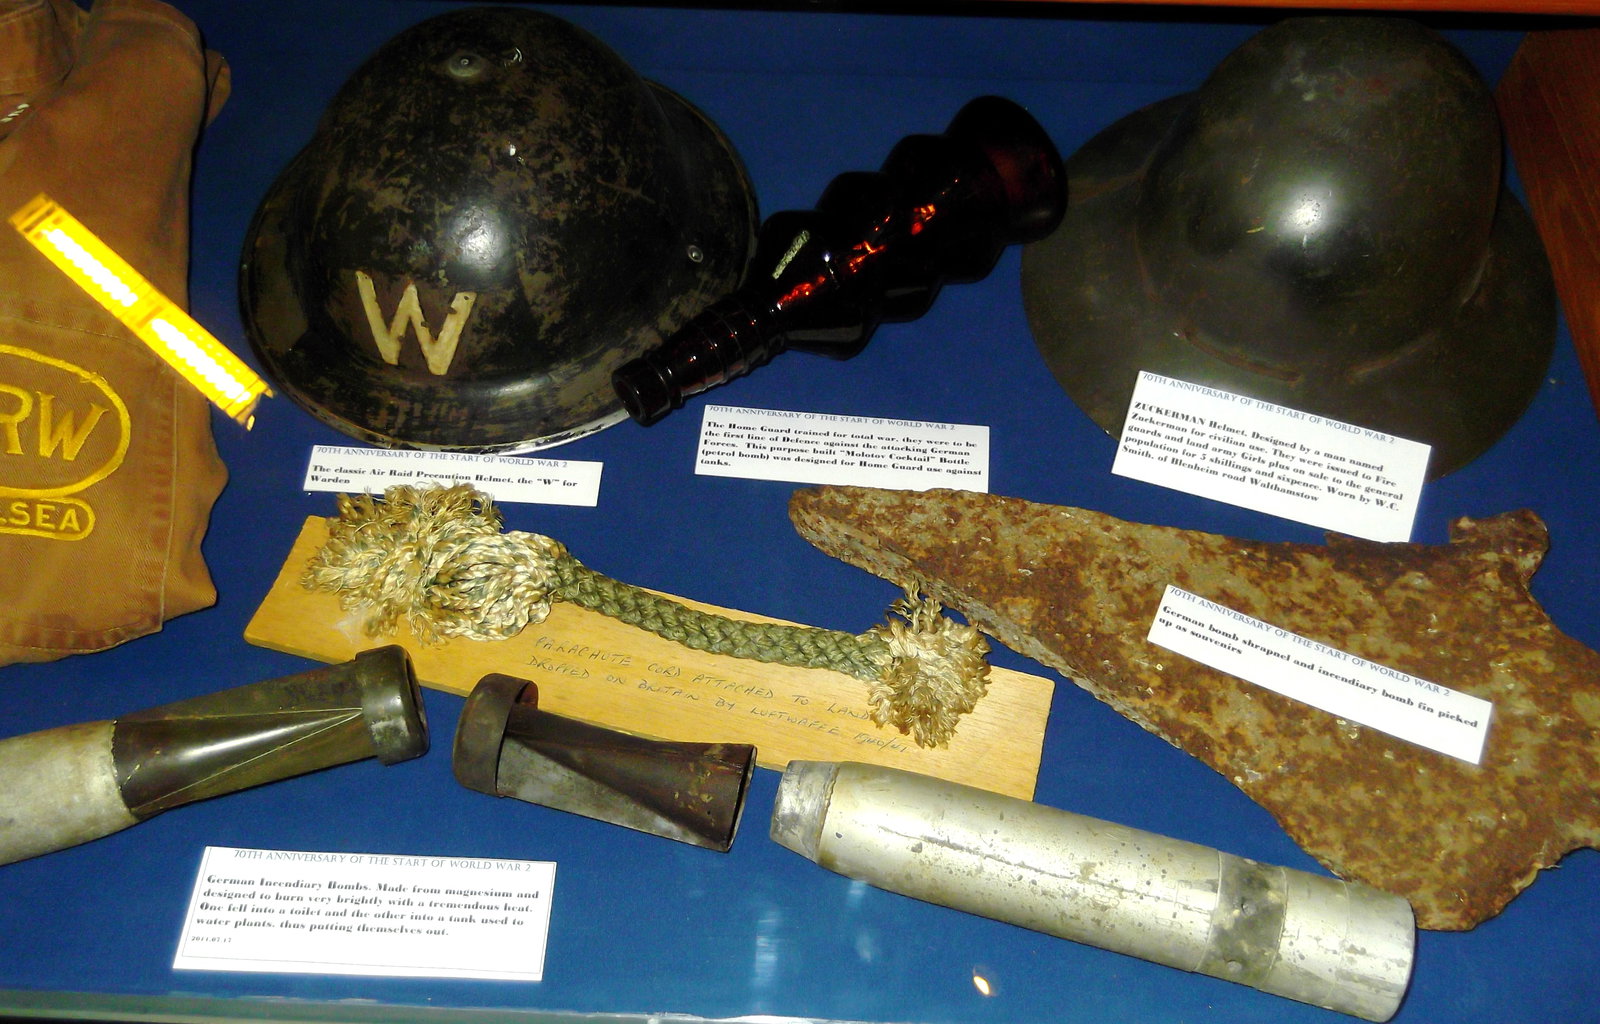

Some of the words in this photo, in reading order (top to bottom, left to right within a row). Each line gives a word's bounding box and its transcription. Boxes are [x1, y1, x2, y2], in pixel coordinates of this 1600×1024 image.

[355, 270, 477, 375] W
[1143, 372, 1167, 385] 70TH
[1168, 379, 1238, 402] ANNIVERSARY
[1239, 397, 1254, 406] OF
[1255, 400, 1275, 412] THE
[1275, 406, 1307, 420] START
[1308, 415, 1322, 424] OF
[1324, 419, 1361, 435] WORLD
[1363, 429, 1386, 442] WAR
[1388, 436, 1395, 445] 2
[703, 438, 738, 448] Forces.
[744, 442, 767, 450] This
[812, 447, 836, 455] built
[939, 456, 970, 465] Bottle
[723, 431, 744, 439] first
[781, 436, 820, 445] Defence
[823, 440, 859, 448] against
[880, 445, 927, 454] attacking
[930, 447, 970, 456] German
[728, 422, 757, 431] Home
[759, 425, 791, 434] Guard
[793, 429, 830, 437] trained
[902, 436, 922, 445] they
[1131, 411, 1187, 433] Zuckerman
[1190, 427, 1206, 437] for
[1208, 432, 1245, 448] civilian
[1272, 447, 1296, 462] They
[1299, 457, 1323, 467] were
[1326, 462, 1359, 477] issued
[1361, 472, 1372, 480] to
[1375, 475, 1397, 487] Fire
[1134, 401, 1206, 425] ZUCKERMAN
[1251, 431, 1297, 449] Designed
[1299, 443, 1310, 454] by
[1323, 452, 1346, 462] man
[1348, 458, 1384, 472] named
[310, 474, 350, 484] Warden
[312, 464, 331, 472] The
[334, 466, 366, 474] classic
[369, 468, 386, 476] Air
[388, 469, 413, 477] Raid
[415, 470, 471, 481] Precaution
[562, 479, 578, 487] for
[700, 458, 731, 466] tanks.
[701, 448, 735, 457] (petrol
[738, 450, 770, 460] bomb)
[794, 455, 837, 465] designed
[859, 460, 888, 468] Home
[891, 462, 923, 471] Guard
[945, 467, 981, 476] against
[1124, 436, 1179, 454] population
[1181, 448, 1197, 458] for
[1199, 453, 1207, 461] 5
[1209, 456, 1252, 473] shillings
[1254, 469, 1275, 478] and
[1326, 485, 1356, 500] Worn
[1359, 494, 1371, 505] by
[1127, 425, 1162, 438] guards
[1164, 434, 1184, 443] and
[1186, 437, 1209, 450] land
[1211, 446, 1237, 459] army
[1240, 451, 1266, 464] Girls
[1267, 460, 1290, 471] plus
[1292, 467, 1305, 475] on
[1308, 471, 1329, 480] sale
[1332, 476, 1342, 485] to
[1345, 479, 1362, 489] the
[1363, 486, 1403, 501] general
[1170, 456, 1219, 476] Blenheim
[1221, 472, 1246, 483] road
[1249, 477, 1319, 501] Walthamstow
[0, 502, 80, 531] SEA
[1158, 617, 1173, 627] up
[1175, 624, 1187, 632] as
[1189, 630, 1242, 654] souvenirs
[1169, 587, 1197, 603] 70TH
[1198, 598, 1272, 633] ANNIVERSARY
[1274, 627, 1290, 639] OF
[1291, 634, 1312, 649] THE
[1314, 642, 1349, 662] START
[1351, 656, 1367, 668] OF
[1369, 662, 1410, 683] WORLD
[1413, 678, 1440, 694] WAR
[1443, 688, 1450, 697] 2
[535, 636, 632, 666] PARACHUTE
[648, 663, 681, 678] CORD
[691, 674, 774, 699] ATTACHED
[791, 694, 809, 705] TO
[827, 703, 871, 720] LAND
[1162, 605, 1205, 628] German
[1208, 623, 1239, 641] bomb
[1241, 639, 1291, 661] shrapnel
[1292, 659, 1315, 671] and
[1317, 666, 1377, 694] incendiary
[1381, 688, 1414, 706] bomb
[1417, 701, 1434, 713] fin
[1437, 710, 1478, 728] picked
[528, 656, 590, 679] DROPPED
[607, 675, 626, 685] ON
[638, 679, 699, 700] BRITAIN
[715, 697, 735, 711] BY
[750, 707, 840, 735] LUFTWAFFE
[202, 888, 256, 900] designed
[259, 892, 271, 900] to
[274, 891, 304, 902] burn
[308, 896, 331, 905] very
[336, 894, 382, 907] brightly
[388, 897, 414, 906] with
[428, 900, 500, 910] tremendous
[206, 874, 255, 885] German
[259, 877, 322, 890] Incendiary
[375, 882, 408, 892] Made
[412, 884, 441, 894] from
[444, 888, 512, 898] magnesium
[516, 890, 539, 899] and
[196, 918, 231, 926] water
[279, 919, 305, 929] thus
[308, 921, 353, 933] putting
[356, 923, 422, 934] themselves
